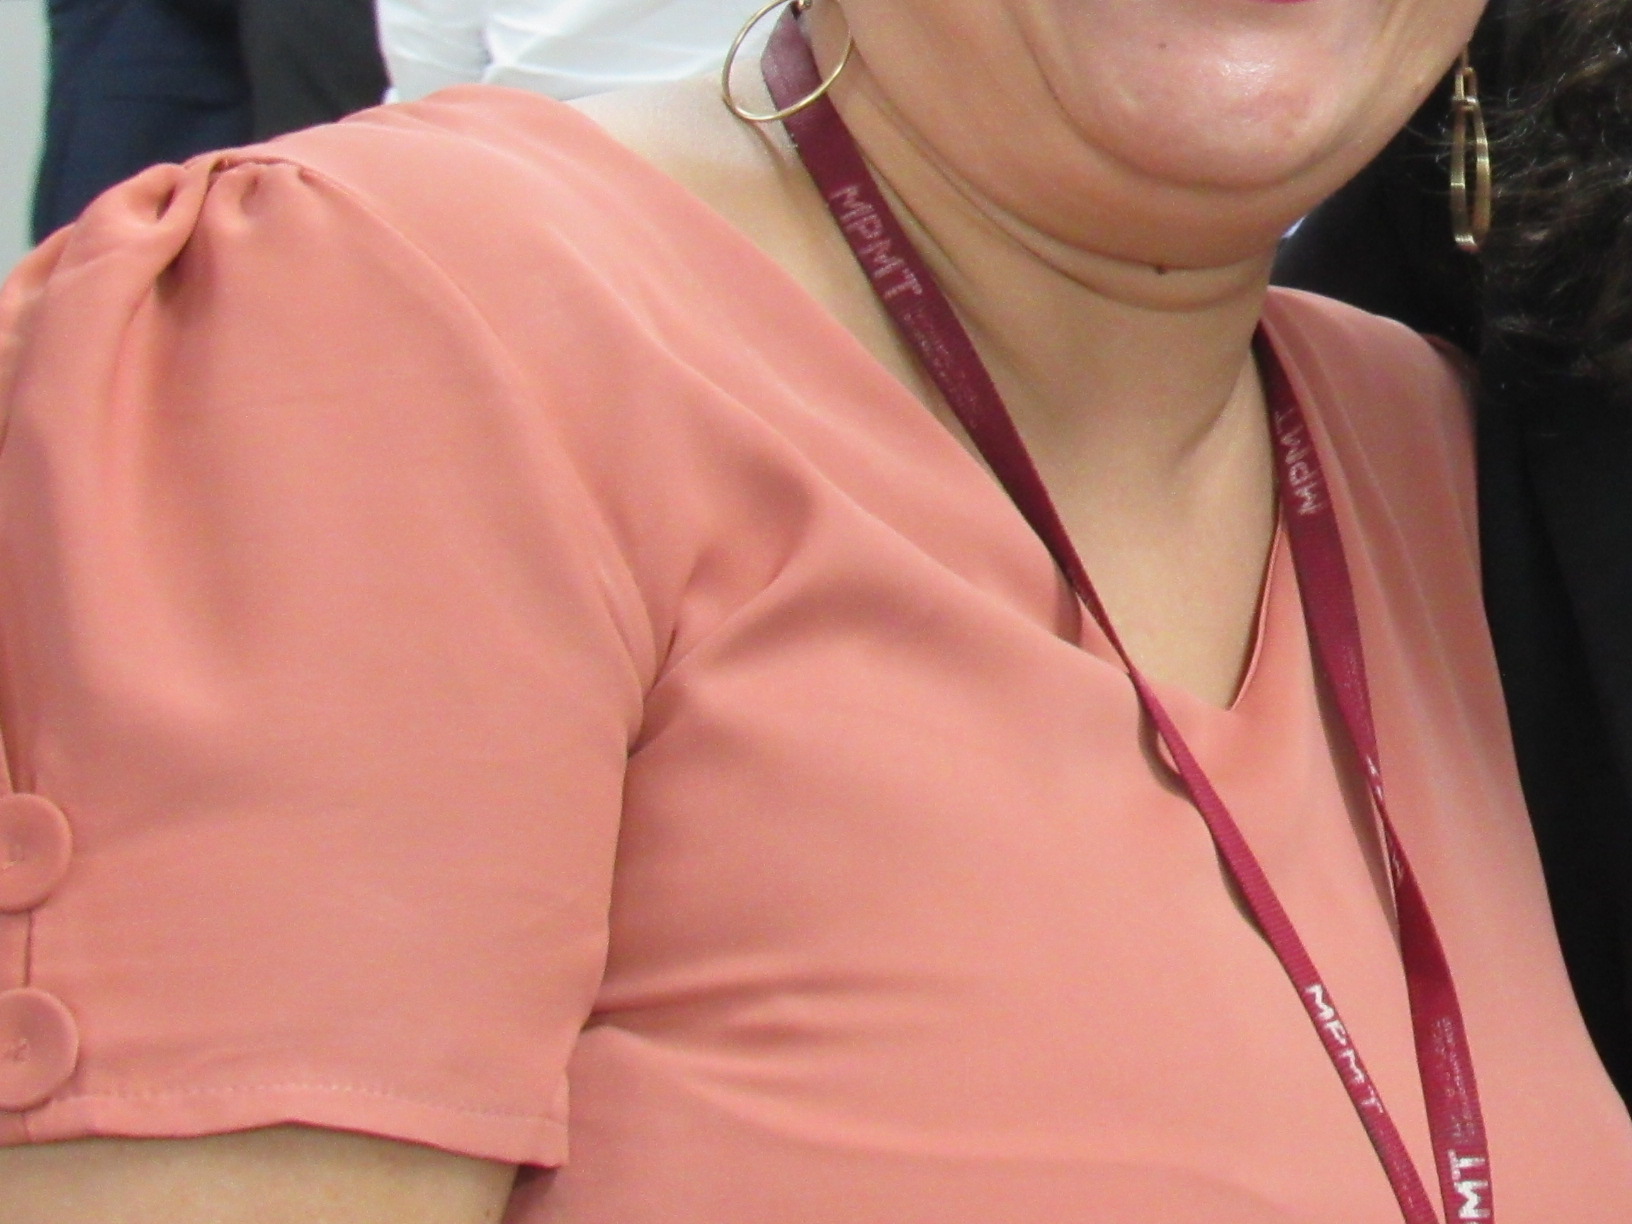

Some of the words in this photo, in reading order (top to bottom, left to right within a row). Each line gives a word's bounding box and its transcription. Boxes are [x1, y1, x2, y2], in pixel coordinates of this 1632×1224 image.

[829, 184, 922, 300] MPMT
[1275, 407, 1323, 515] MPMT
[1305, 983, 1384, 1114] MPMT
